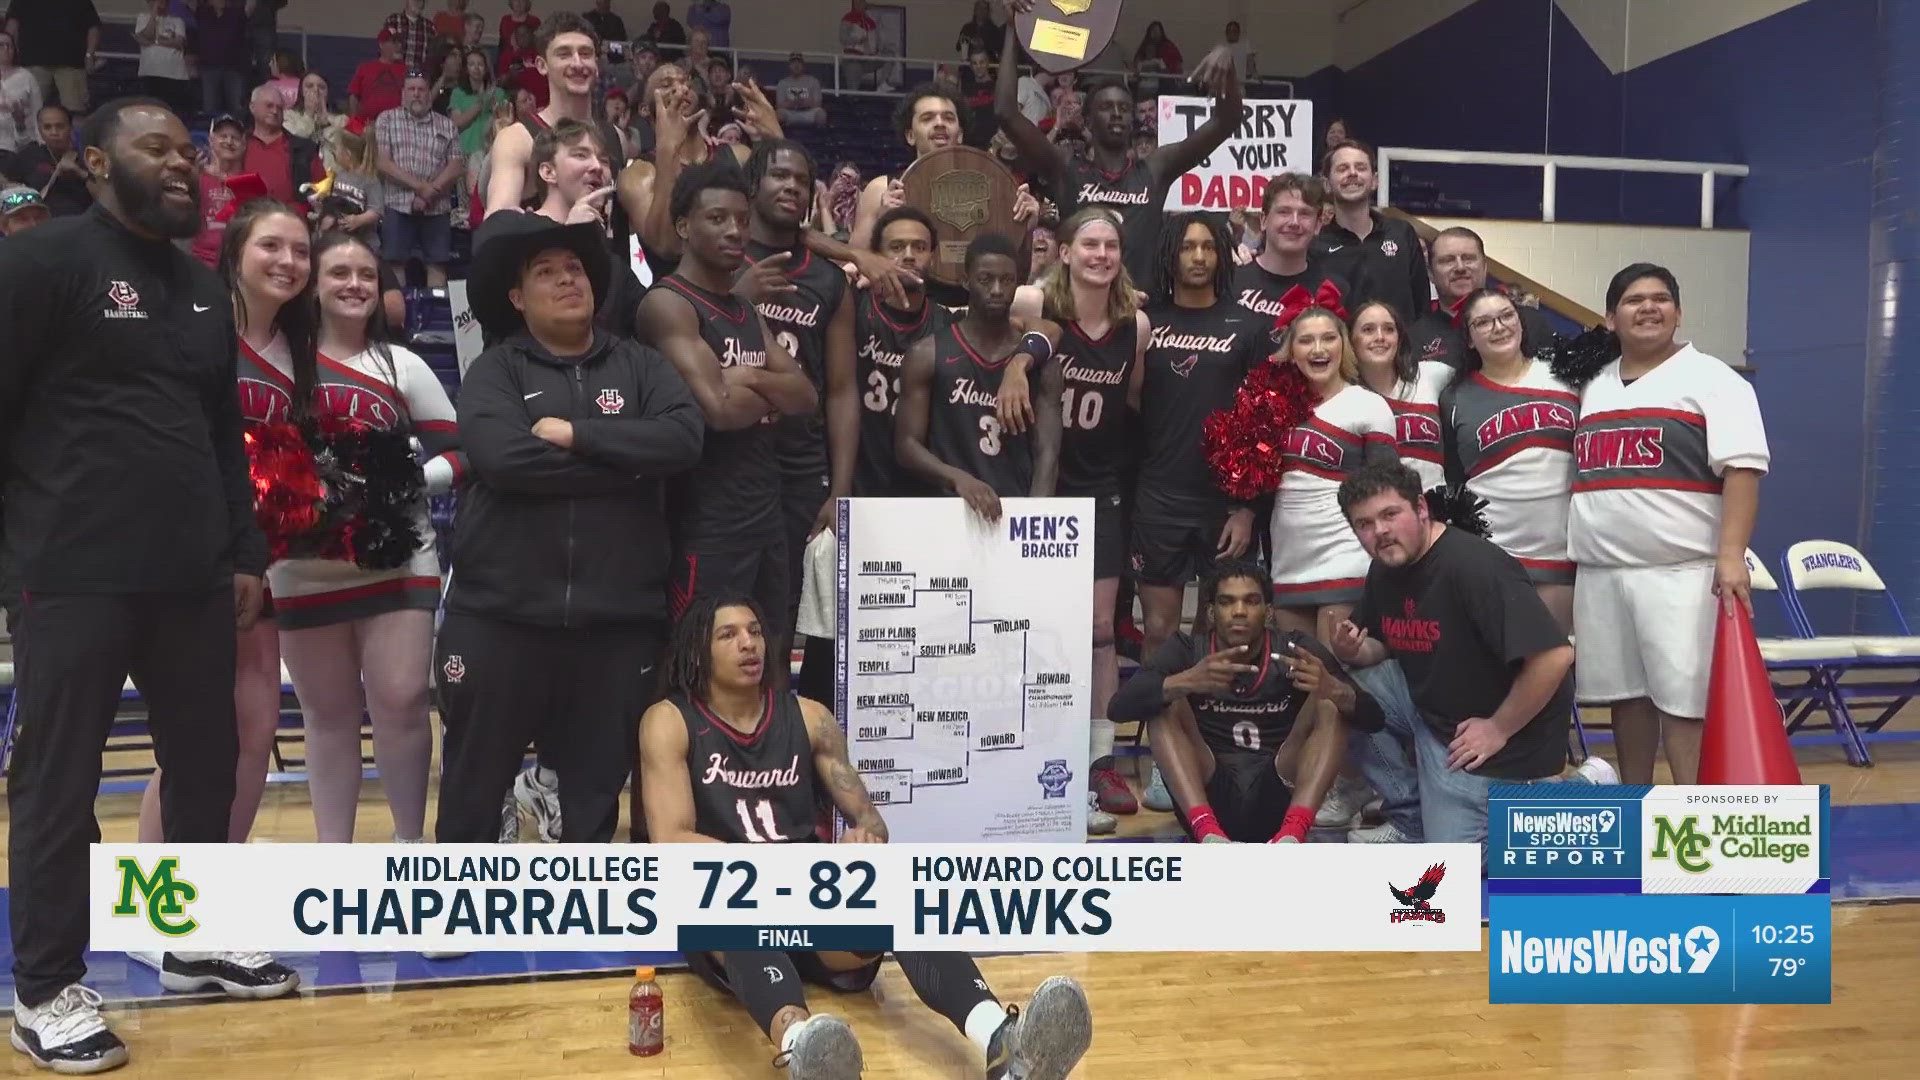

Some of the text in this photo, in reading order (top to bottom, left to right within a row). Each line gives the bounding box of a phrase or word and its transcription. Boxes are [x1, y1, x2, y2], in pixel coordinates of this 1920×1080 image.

[1175, 103, 1297, 139] TRRY
[1229, 143, 1288, 171] YOUR
[1077, 183, 1149, 205] Howard
[1182, 173, 1274, 208] DADD
[756, 302, 821, 328] oward
[1145, 325, 1237, 353] Howard
[1061, 388, 1104, 430] 10
[1476, 401, 1577, 452] HAWKS
[1574, 427, 1665, 474] HAWKS
[1010, 516, 1079, 542] MEN'S
[1022, 543, 1079, 558] BRACKET
[862, 561, 902, 573] MIDLAND
[1801, 552, 1863, 573] WRANGLERS
[930, 577, 969, 589] MIDLAND
[860, 593, 906, 606] MCLENNAN
[859, 627, 916, 640] SOUTH PLAINS
[993, 619, 1030, 634] MIDLAND
[1382, 616, 1441, 641] HAWKS
[920, 645, 946, 656] SOUTH
[948, 643, 976, 655] PLAINS
[858, 661, 890, 672] TEMPLE
[1036, 672, 1071, 684] HOWARD
[857, 693, 910, 706] NEW MEXICO
[916, 711, 969, 723] NEW MEXICO
[858, 727, 887, 738] COLLIN
[1232, 720, 1261, 751] 0
[980, 733, 1016, 748] HOWARD
[702, 752, 799, 789] Howard
[858, 759, 895, 770] HOWARD
[927, 768, 963, 782] HOWARD
[869, 791, 891, 803] NGER
